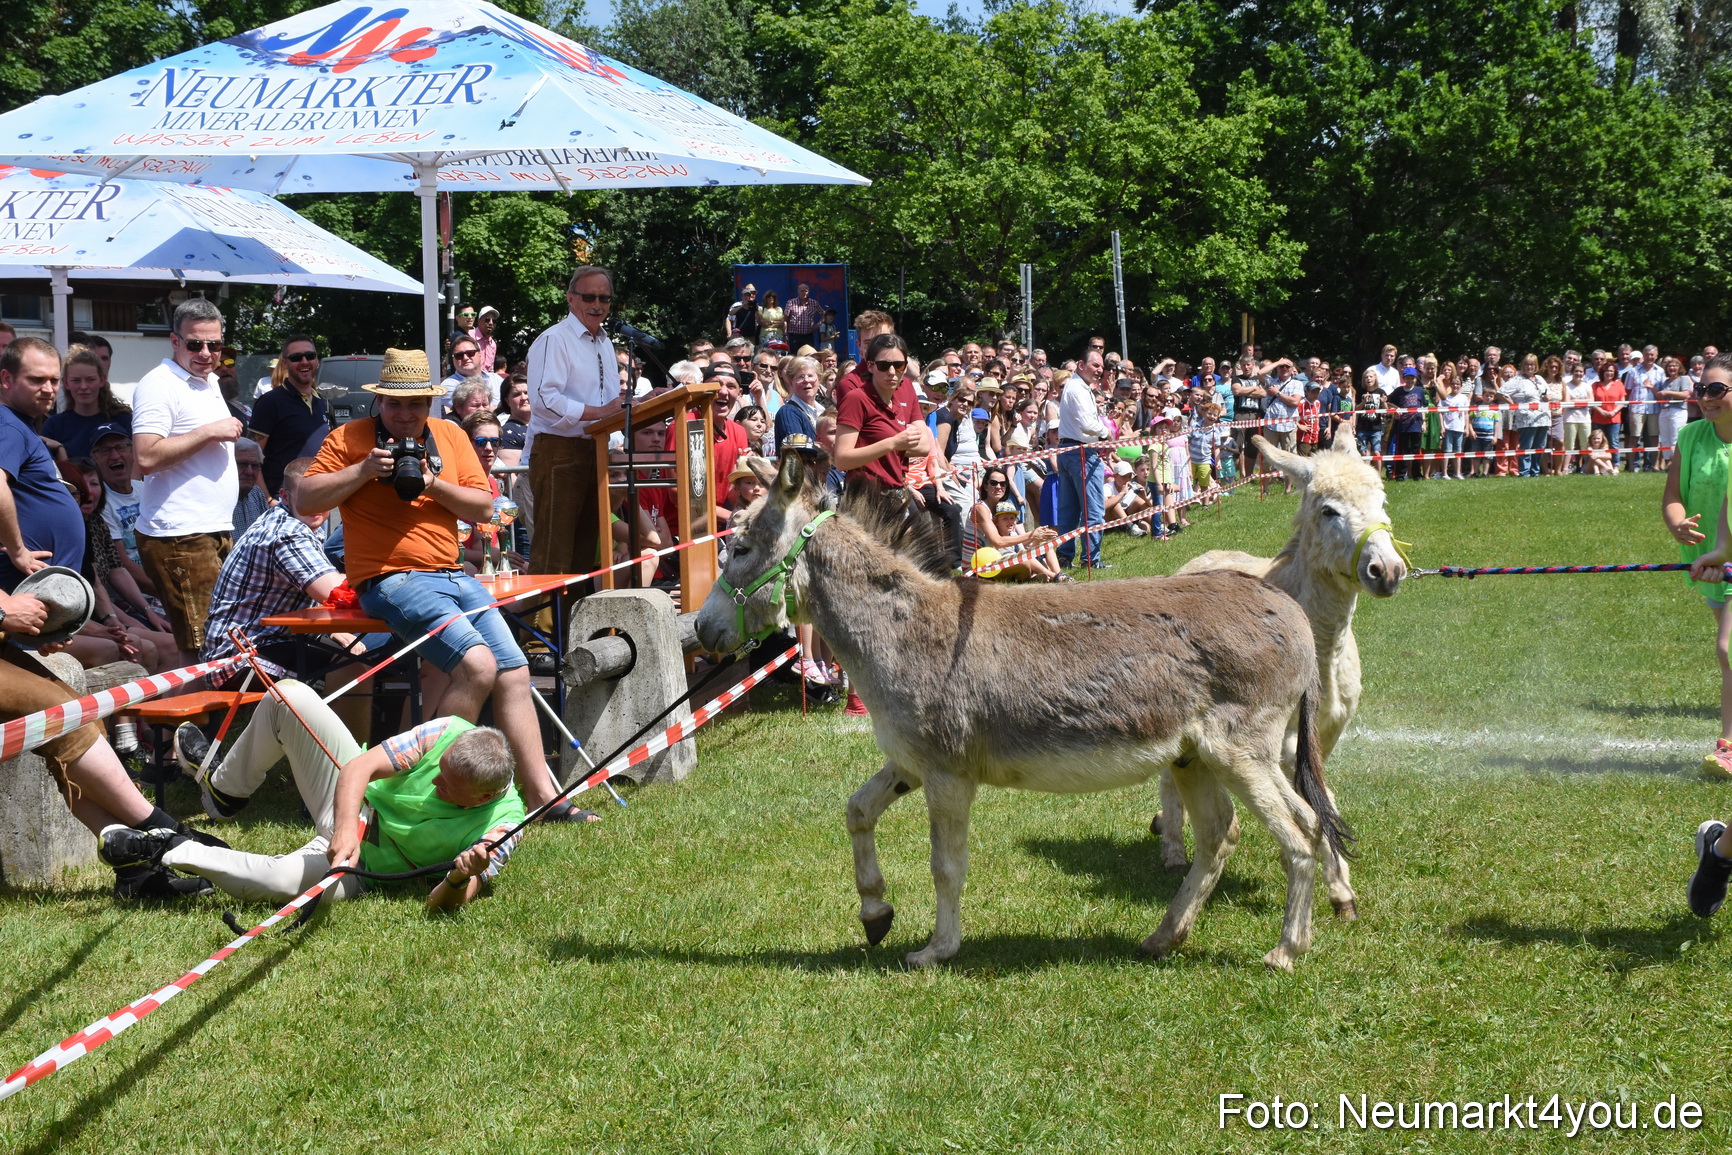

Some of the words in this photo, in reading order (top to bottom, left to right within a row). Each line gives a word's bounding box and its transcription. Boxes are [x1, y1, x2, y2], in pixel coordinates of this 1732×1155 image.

[132, 64, 494, 109] NEUMARKTER
[150, 108, 430, 131] MINERALBRUNNEN
[113, 132, 245, 147] WASSER
[249, 135, 325, 147] ZUM
[335, 130, 436, 145] LEBEN
